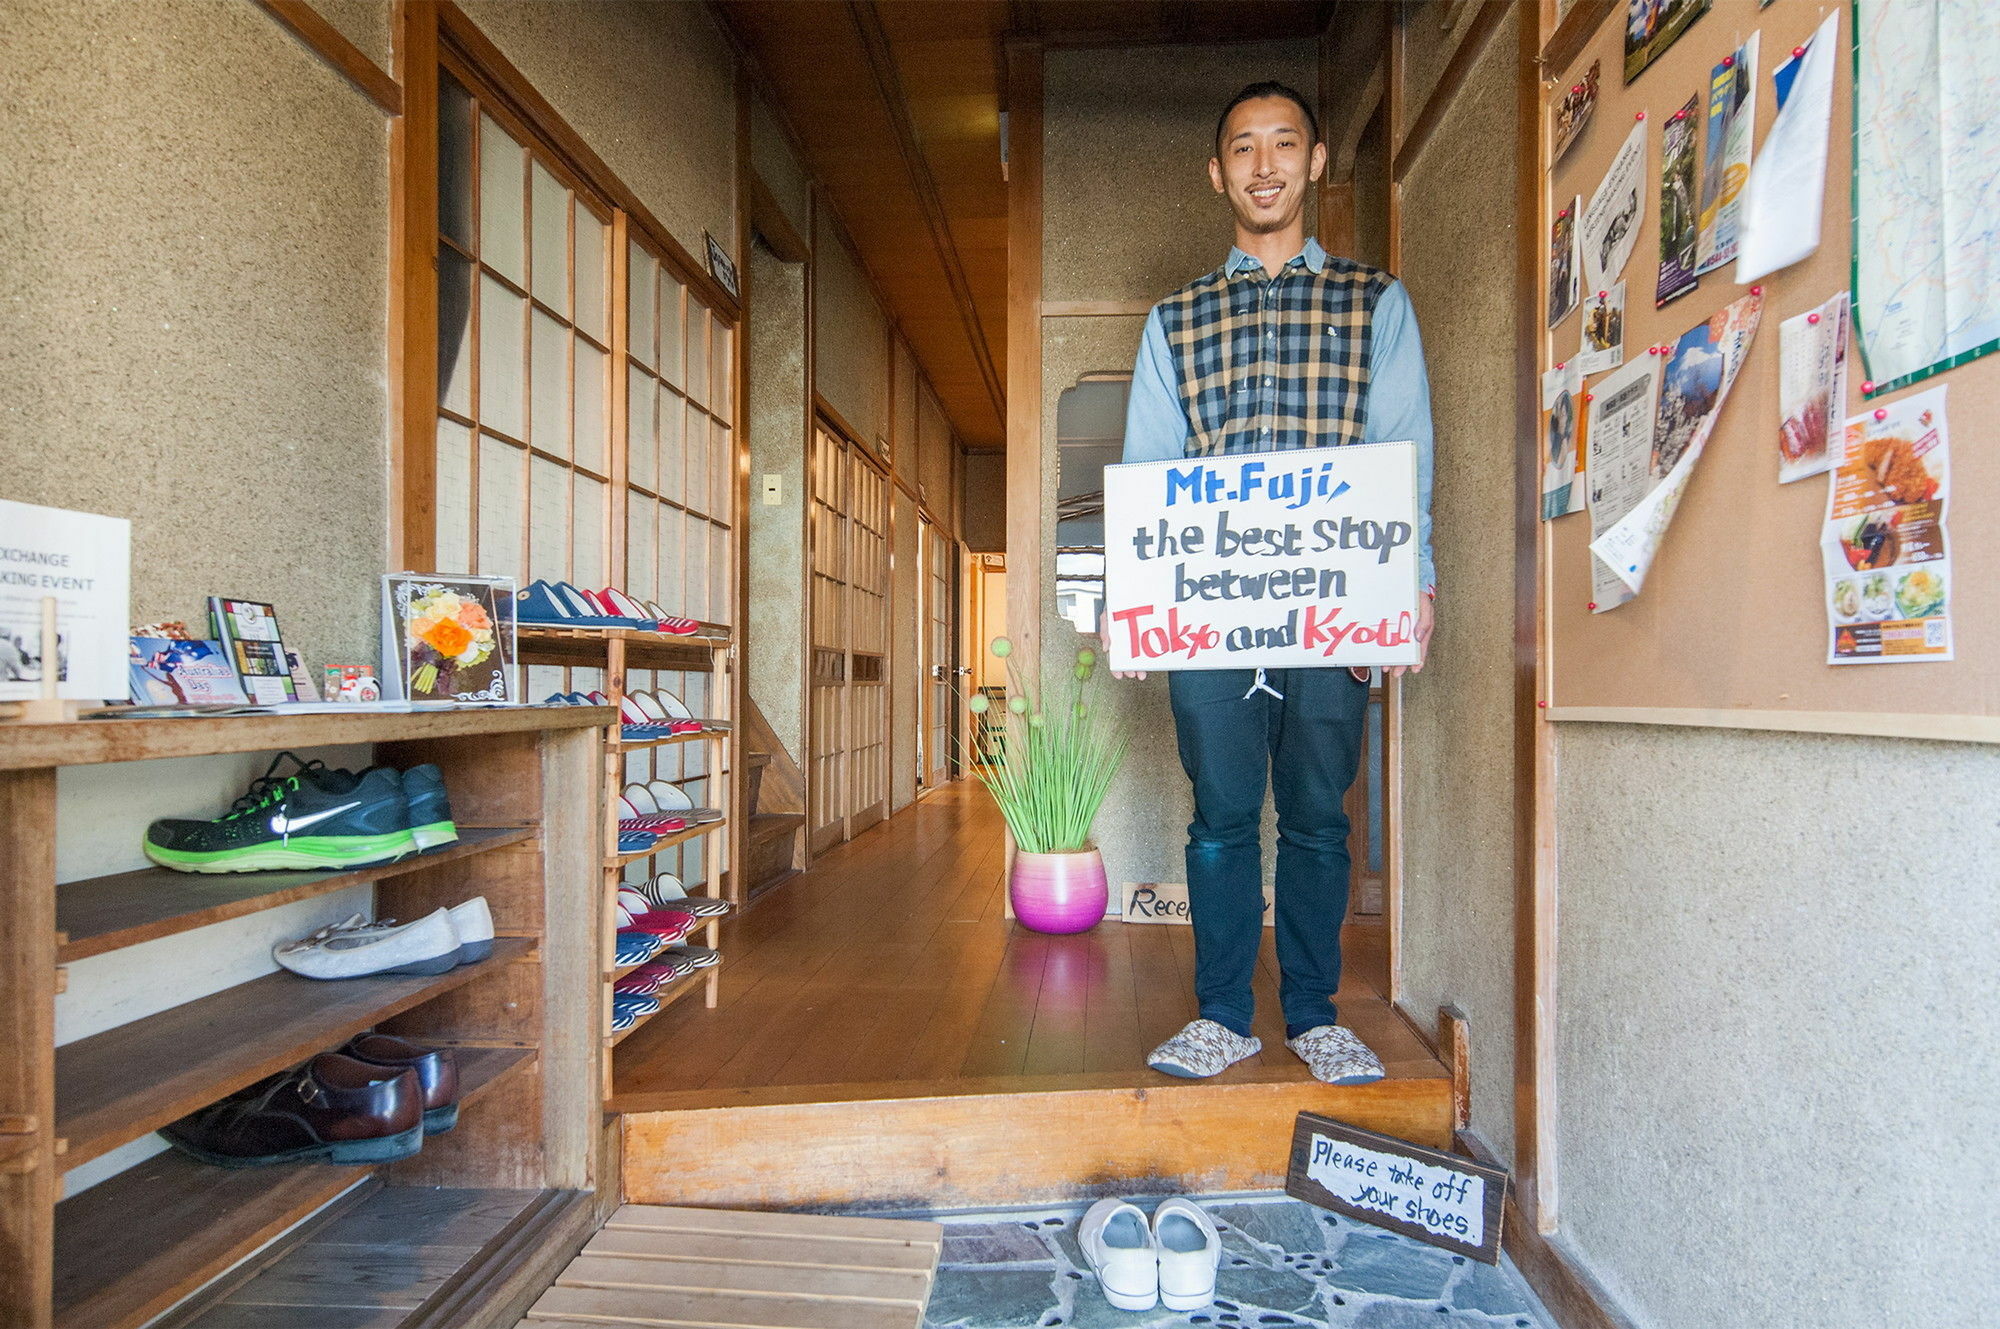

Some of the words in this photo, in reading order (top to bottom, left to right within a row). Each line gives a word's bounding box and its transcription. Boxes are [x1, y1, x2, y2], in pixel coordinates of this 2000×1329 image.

[1132, 518, 1204, 561] the
[1215, 511, 1305, 558] best
[0, 571, 37, 587] KING
[41, 575, 95, 590] EVENT
[1174, 563, 1348, 603] between
[1112, 604, 1220, 660] Tokyo
[1226, 608, 1299, 653] and
[1304, 605, 1411, 658] Kyoto
[1313, 1140, 1378, 1177] Please
[1388, 1162, 1424, 1191] take
[1432, 1173, 1472, 1205] off
[1351, 1184, 1399, 1211] your
